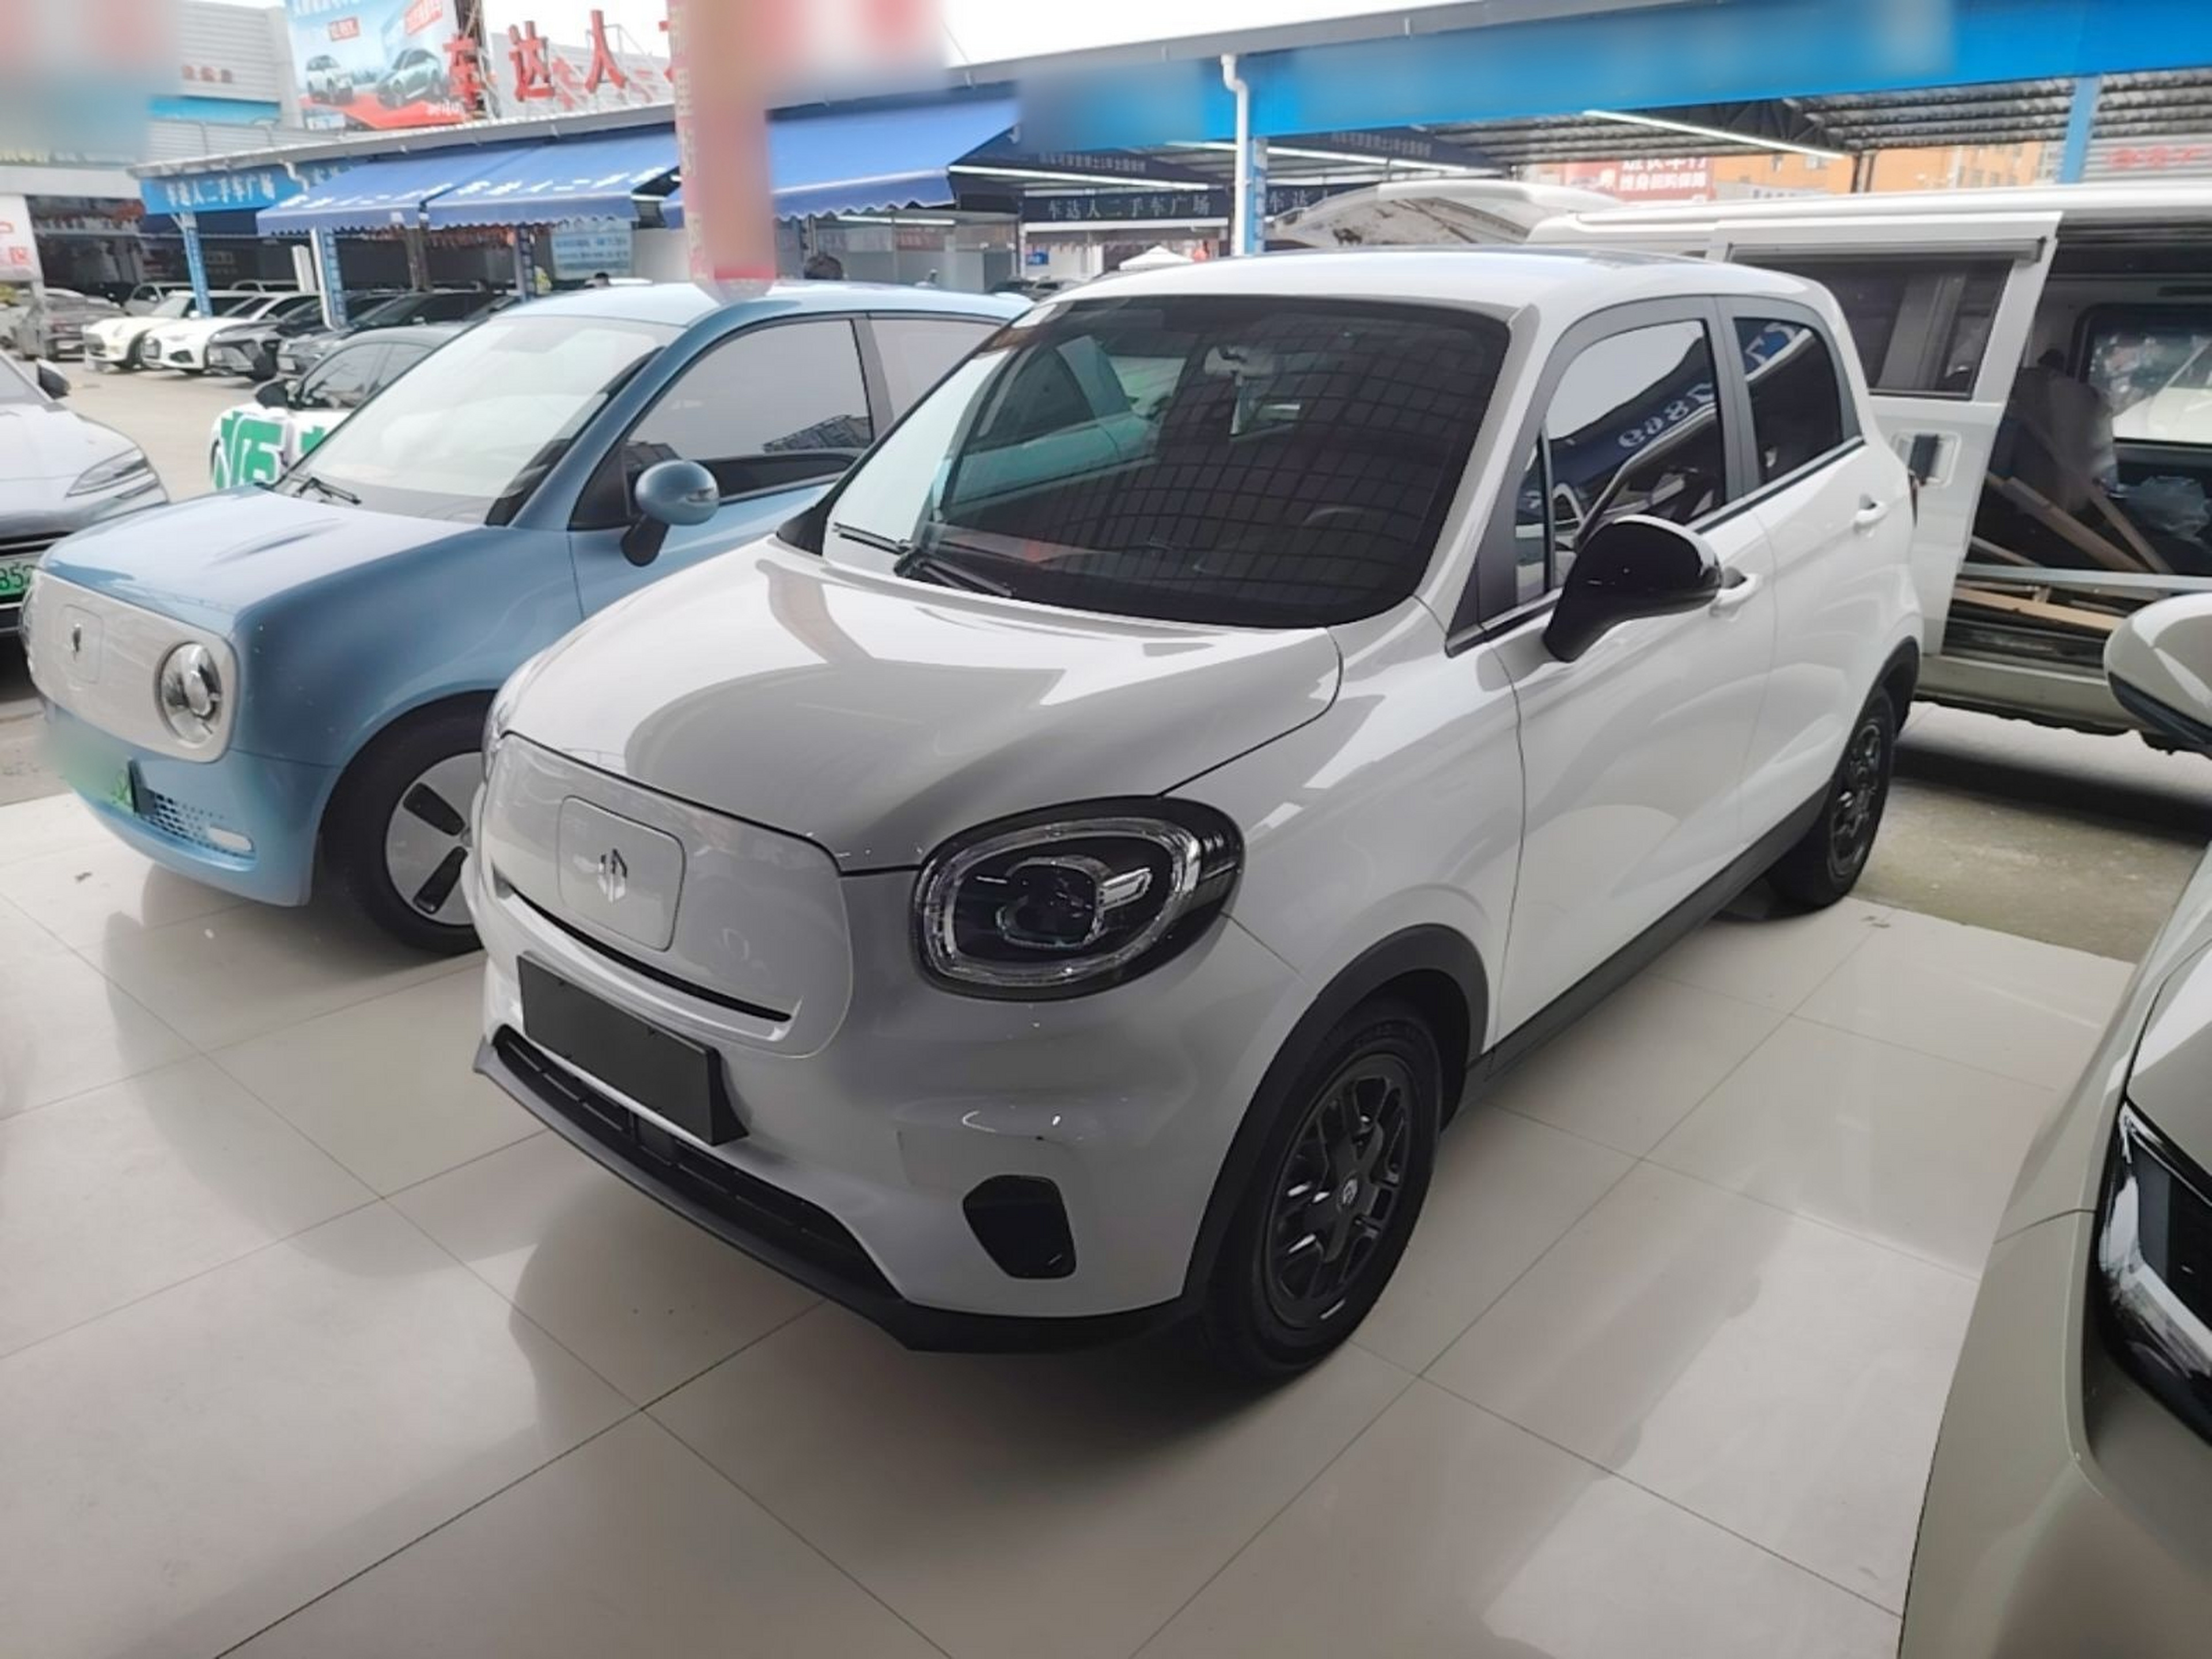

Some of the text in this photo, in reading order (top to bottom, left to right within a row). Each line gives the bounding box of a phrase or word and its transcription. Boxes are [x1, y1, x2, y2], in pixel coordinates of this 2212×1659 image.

[442, 9, 673, 111] 车达人
[1048, 194, 1210, 219] 车达人二手车广场
